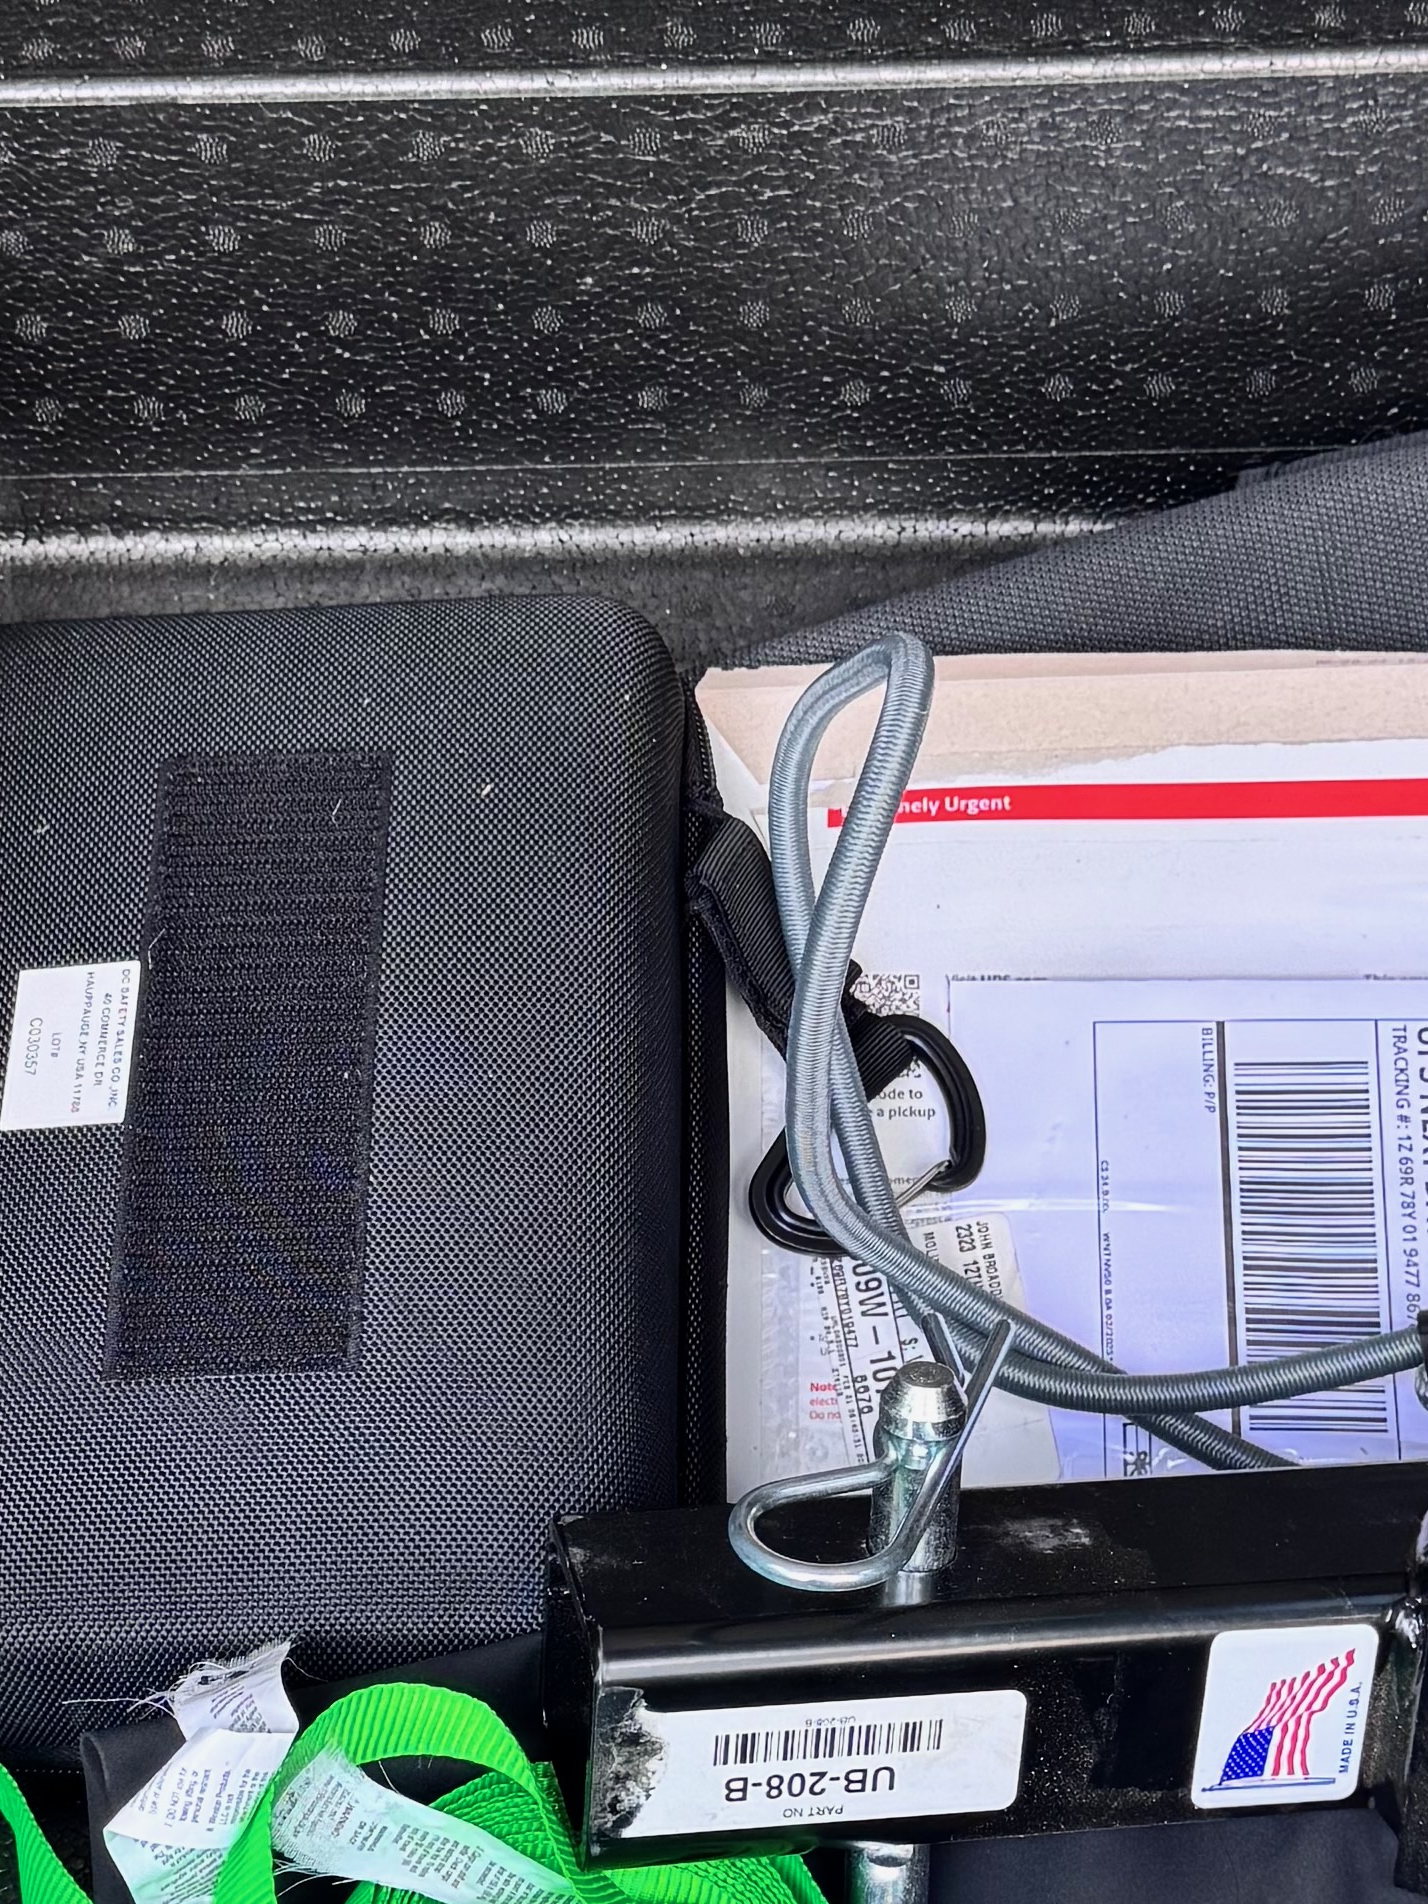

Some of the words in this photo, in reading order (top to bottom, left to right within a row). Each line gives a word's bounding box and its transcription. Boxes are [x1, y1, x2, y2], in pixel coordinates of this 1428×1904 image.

[944, 795, 1012, 816] Urgent
[117, 987, 129, 1027] SAFETY
[95, 1006, 110, 1068] COMMERCE
[112, 1029, 125, 1064] SALES
[74, 1058, 85, 1080] USA
[1200, 1027, 1215, 1089] BILLING:
[1391, 1025, 1412, 1109] TRACKING
[877, 1089, 905, 1100] ode
[909, 1089, 923, 1100] to
[1202, 1091, 1216, 1114] P/P
[876, 1108, 885, 1118] a
[888, 1106, 936, 1120] pickup
[1395, 1113, 1413, 1130] #:
[1397, 1134, 1414, 1153] 1Z
[1398, 1156, 1415, 1186] 69R
[1400, 1191, 1417, 1220] 78Y
[954, 1223, 976, 1253] 2323
[975, 1219, 994, 1250] JOHN
[1401, 1224, 1418, 1244] 01
[982, 1252, 1003, 1300] BROADD
[1402, 1247, 1420, 1288] 9477
[1346, 1682, 1363, 1719] U.S.A.
[1344, 1722, 1356, 1735] IN
[1338, 1739, 1353, 1774] MADE
[722, 1765, 897, 1803] UB-208-B
[781, 1806, 805, 1819] NO
[806, 1804, 845, 1818] PART
